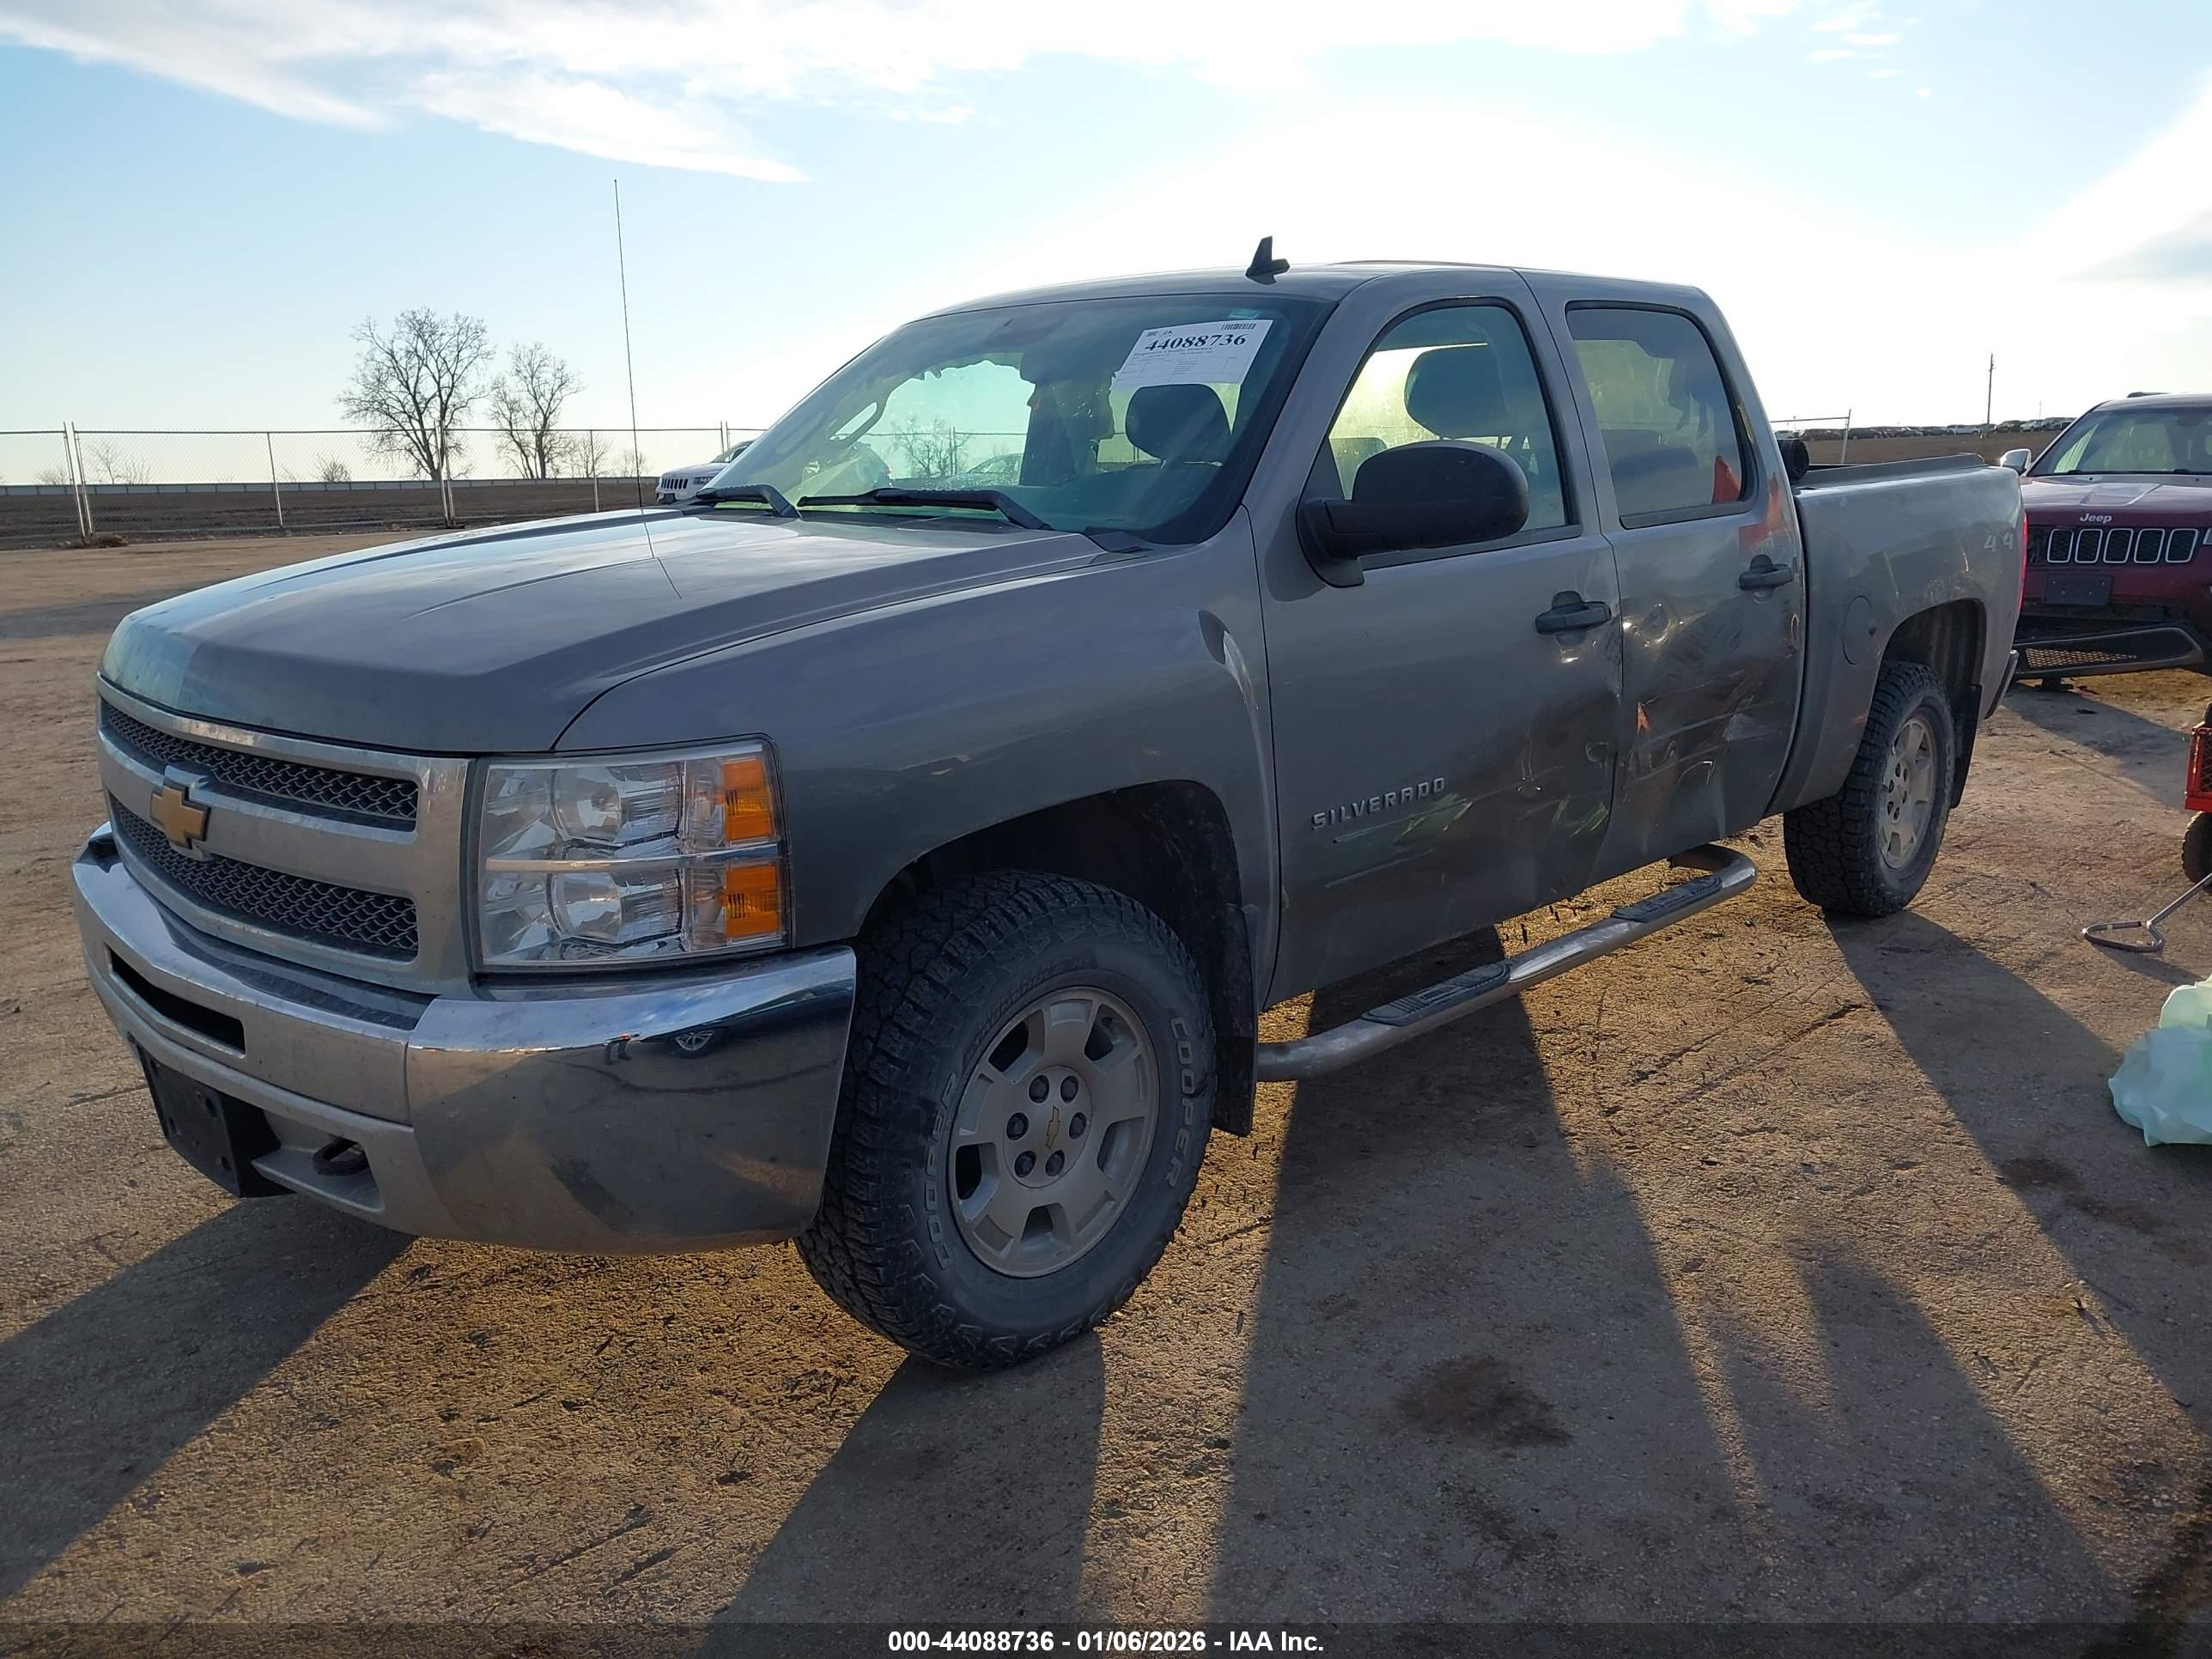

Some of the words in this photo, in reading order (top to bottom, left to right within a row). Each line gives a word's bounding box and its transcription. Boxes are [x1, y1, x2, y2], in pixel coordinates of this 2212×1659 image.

[1145, 333, 1249, 351] 44088736
[2080, 513, 2112, 523] Jeep
[1312, 776, 1445, 830] SILVERADO
[1170, 1016, 1195, 1189] COOPER
